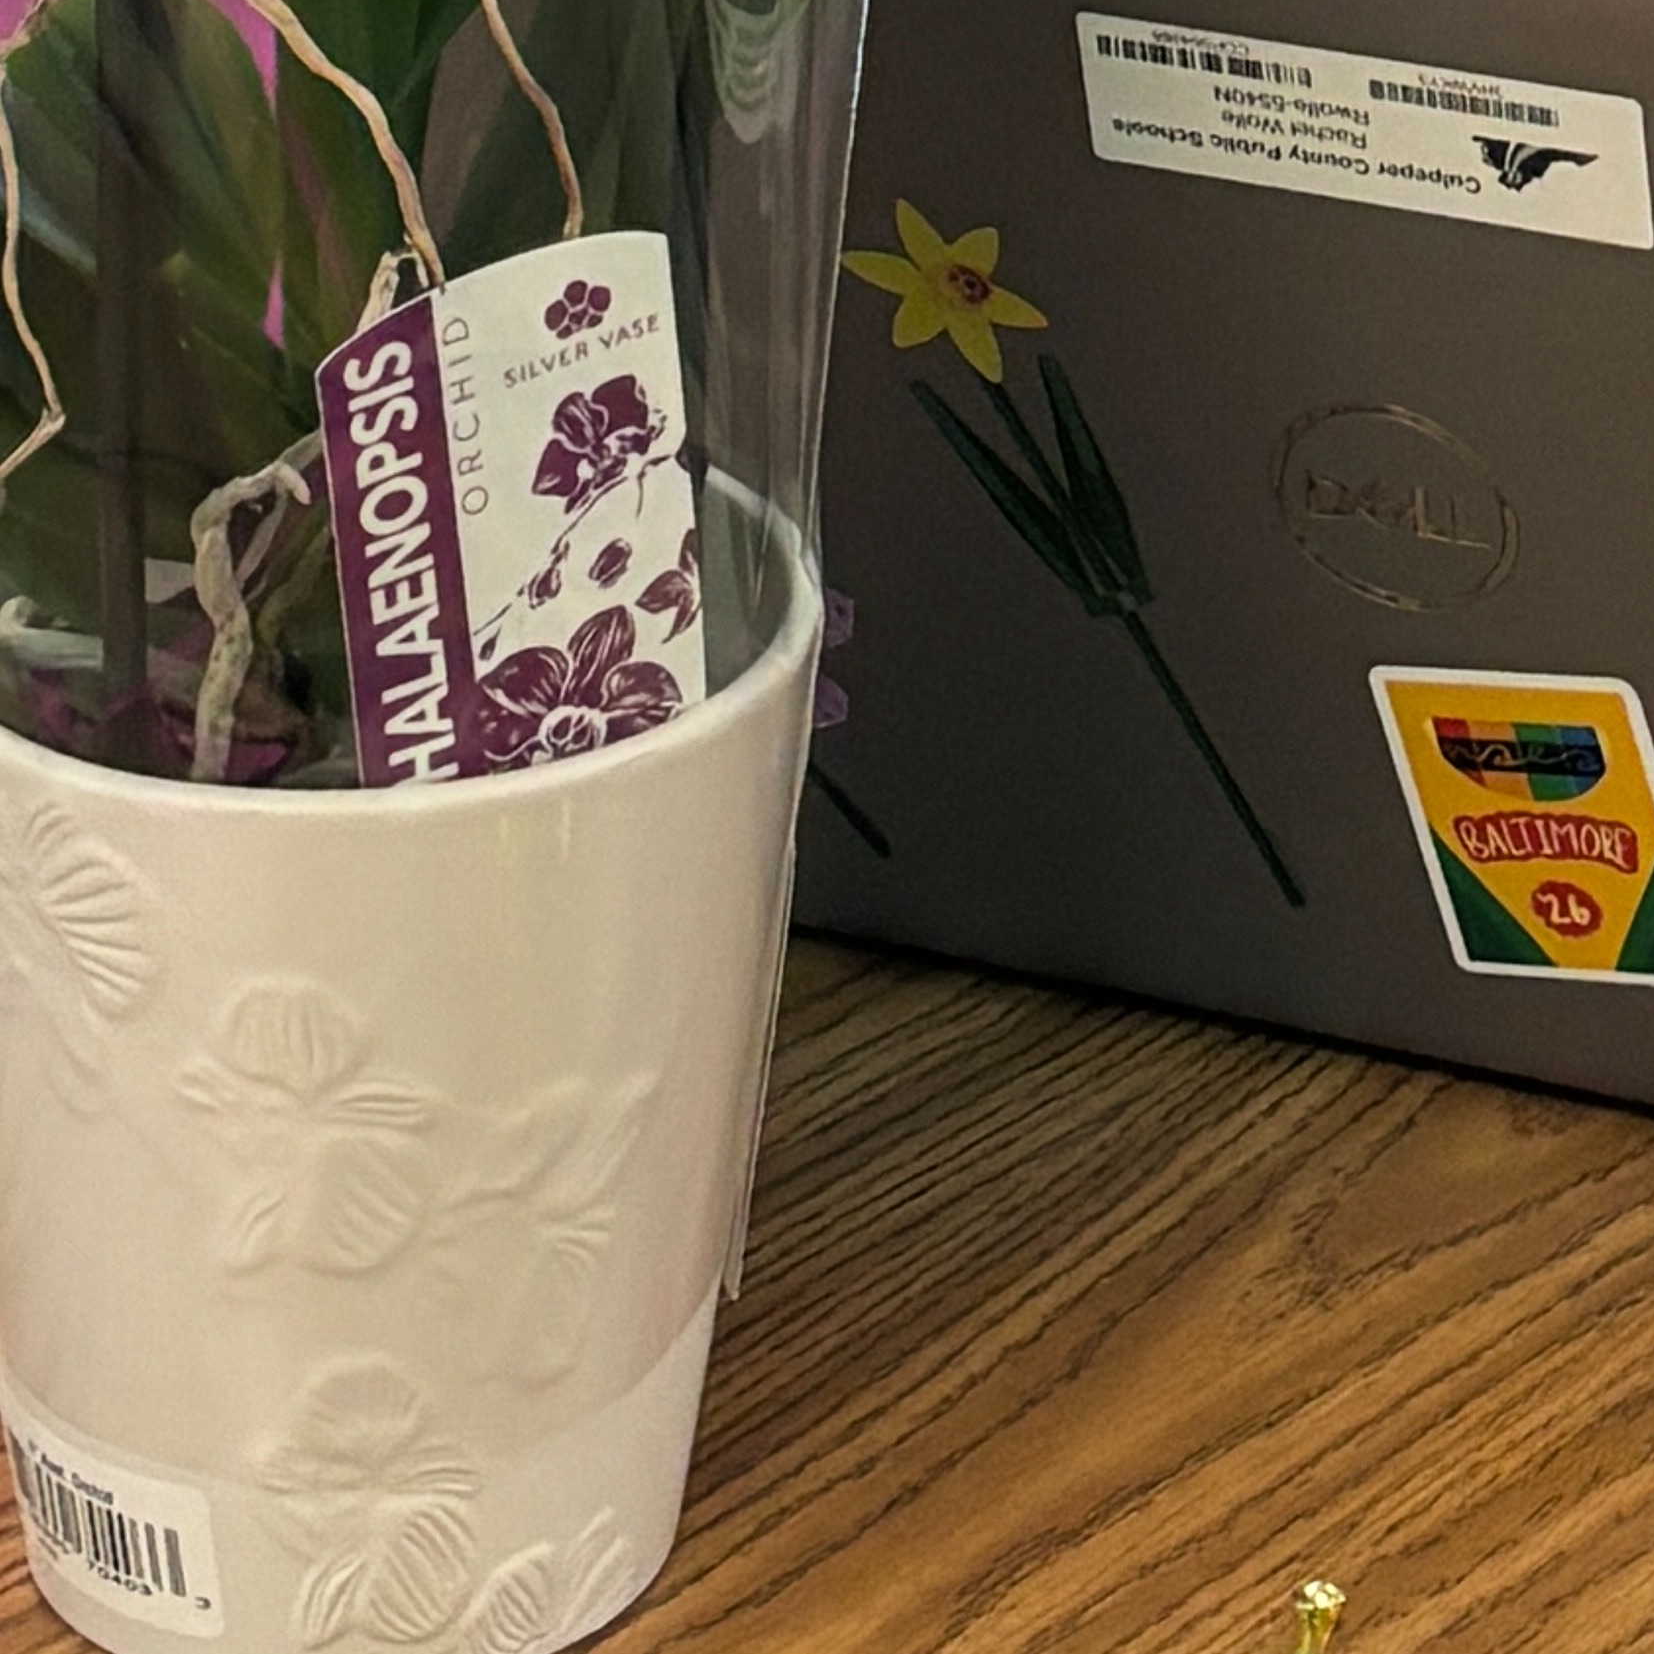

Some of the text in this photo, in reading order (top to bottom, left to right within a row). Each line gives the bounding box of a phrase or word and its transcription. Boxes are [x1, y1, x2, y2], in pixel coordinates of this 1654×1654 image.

[1111, 116, 1482, 194] Culpeper County Public Schools
[1289, 124, 1368, 150] Rachel
[503, 313, 661, 389] SILVER VASE
[442, 315, 490, 516] ORCHID
[343, 339, 459, 786] HALAENOPSIS
[1458, 815, 1635, 871] BALTIMORE
[1536, 892, 1592, 925] 26
